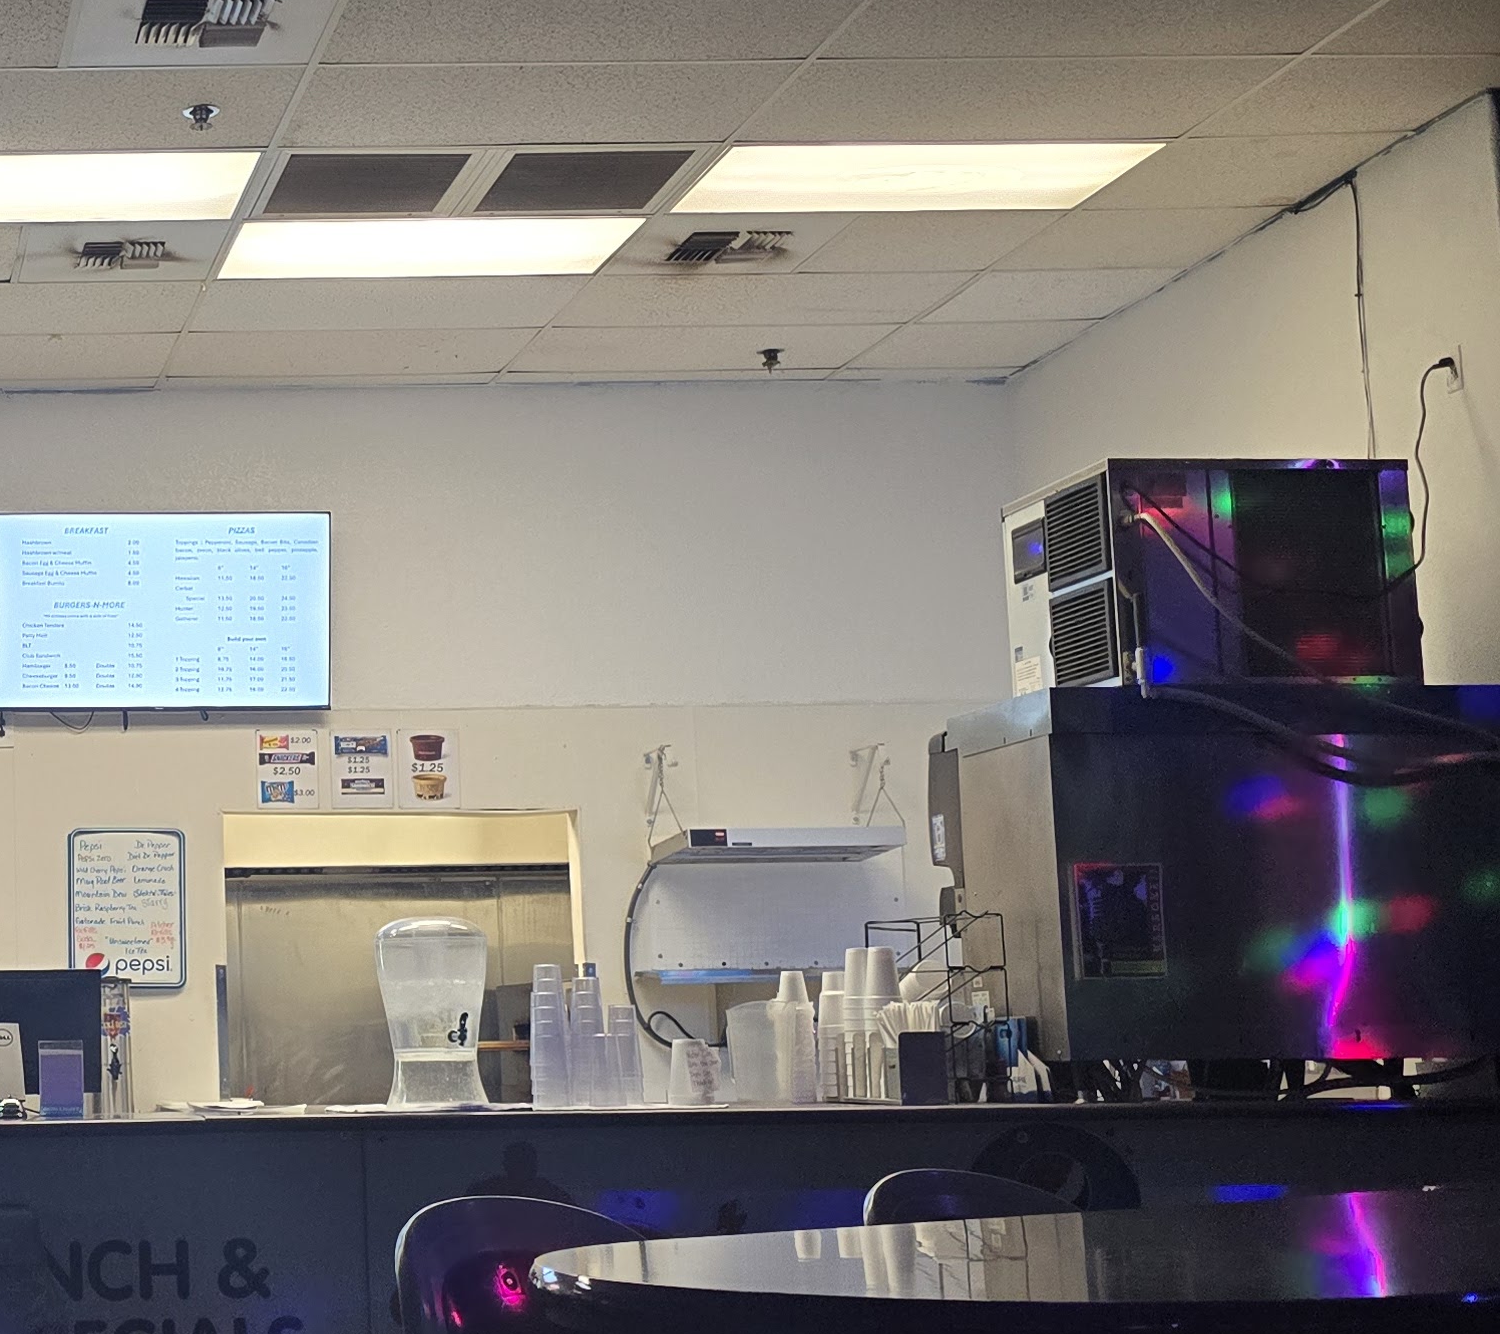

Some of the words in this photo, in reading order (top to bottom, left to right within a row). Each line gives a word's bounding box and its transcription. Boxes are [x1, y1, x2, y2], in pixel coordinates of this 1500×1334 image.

[273, 766, 301, 776] $2.50
[348, 766, 370, 774] $1.25
[411, 763, 444, 773] $1.25
[80, 839, 102, 852] Pepsi
[134, 876, 166, 884] Lemonade
[115, 956, 170, 975] pepsi
[44, 1238, 190, 1303] NCH
[217, 1237, 271, 1298] &
